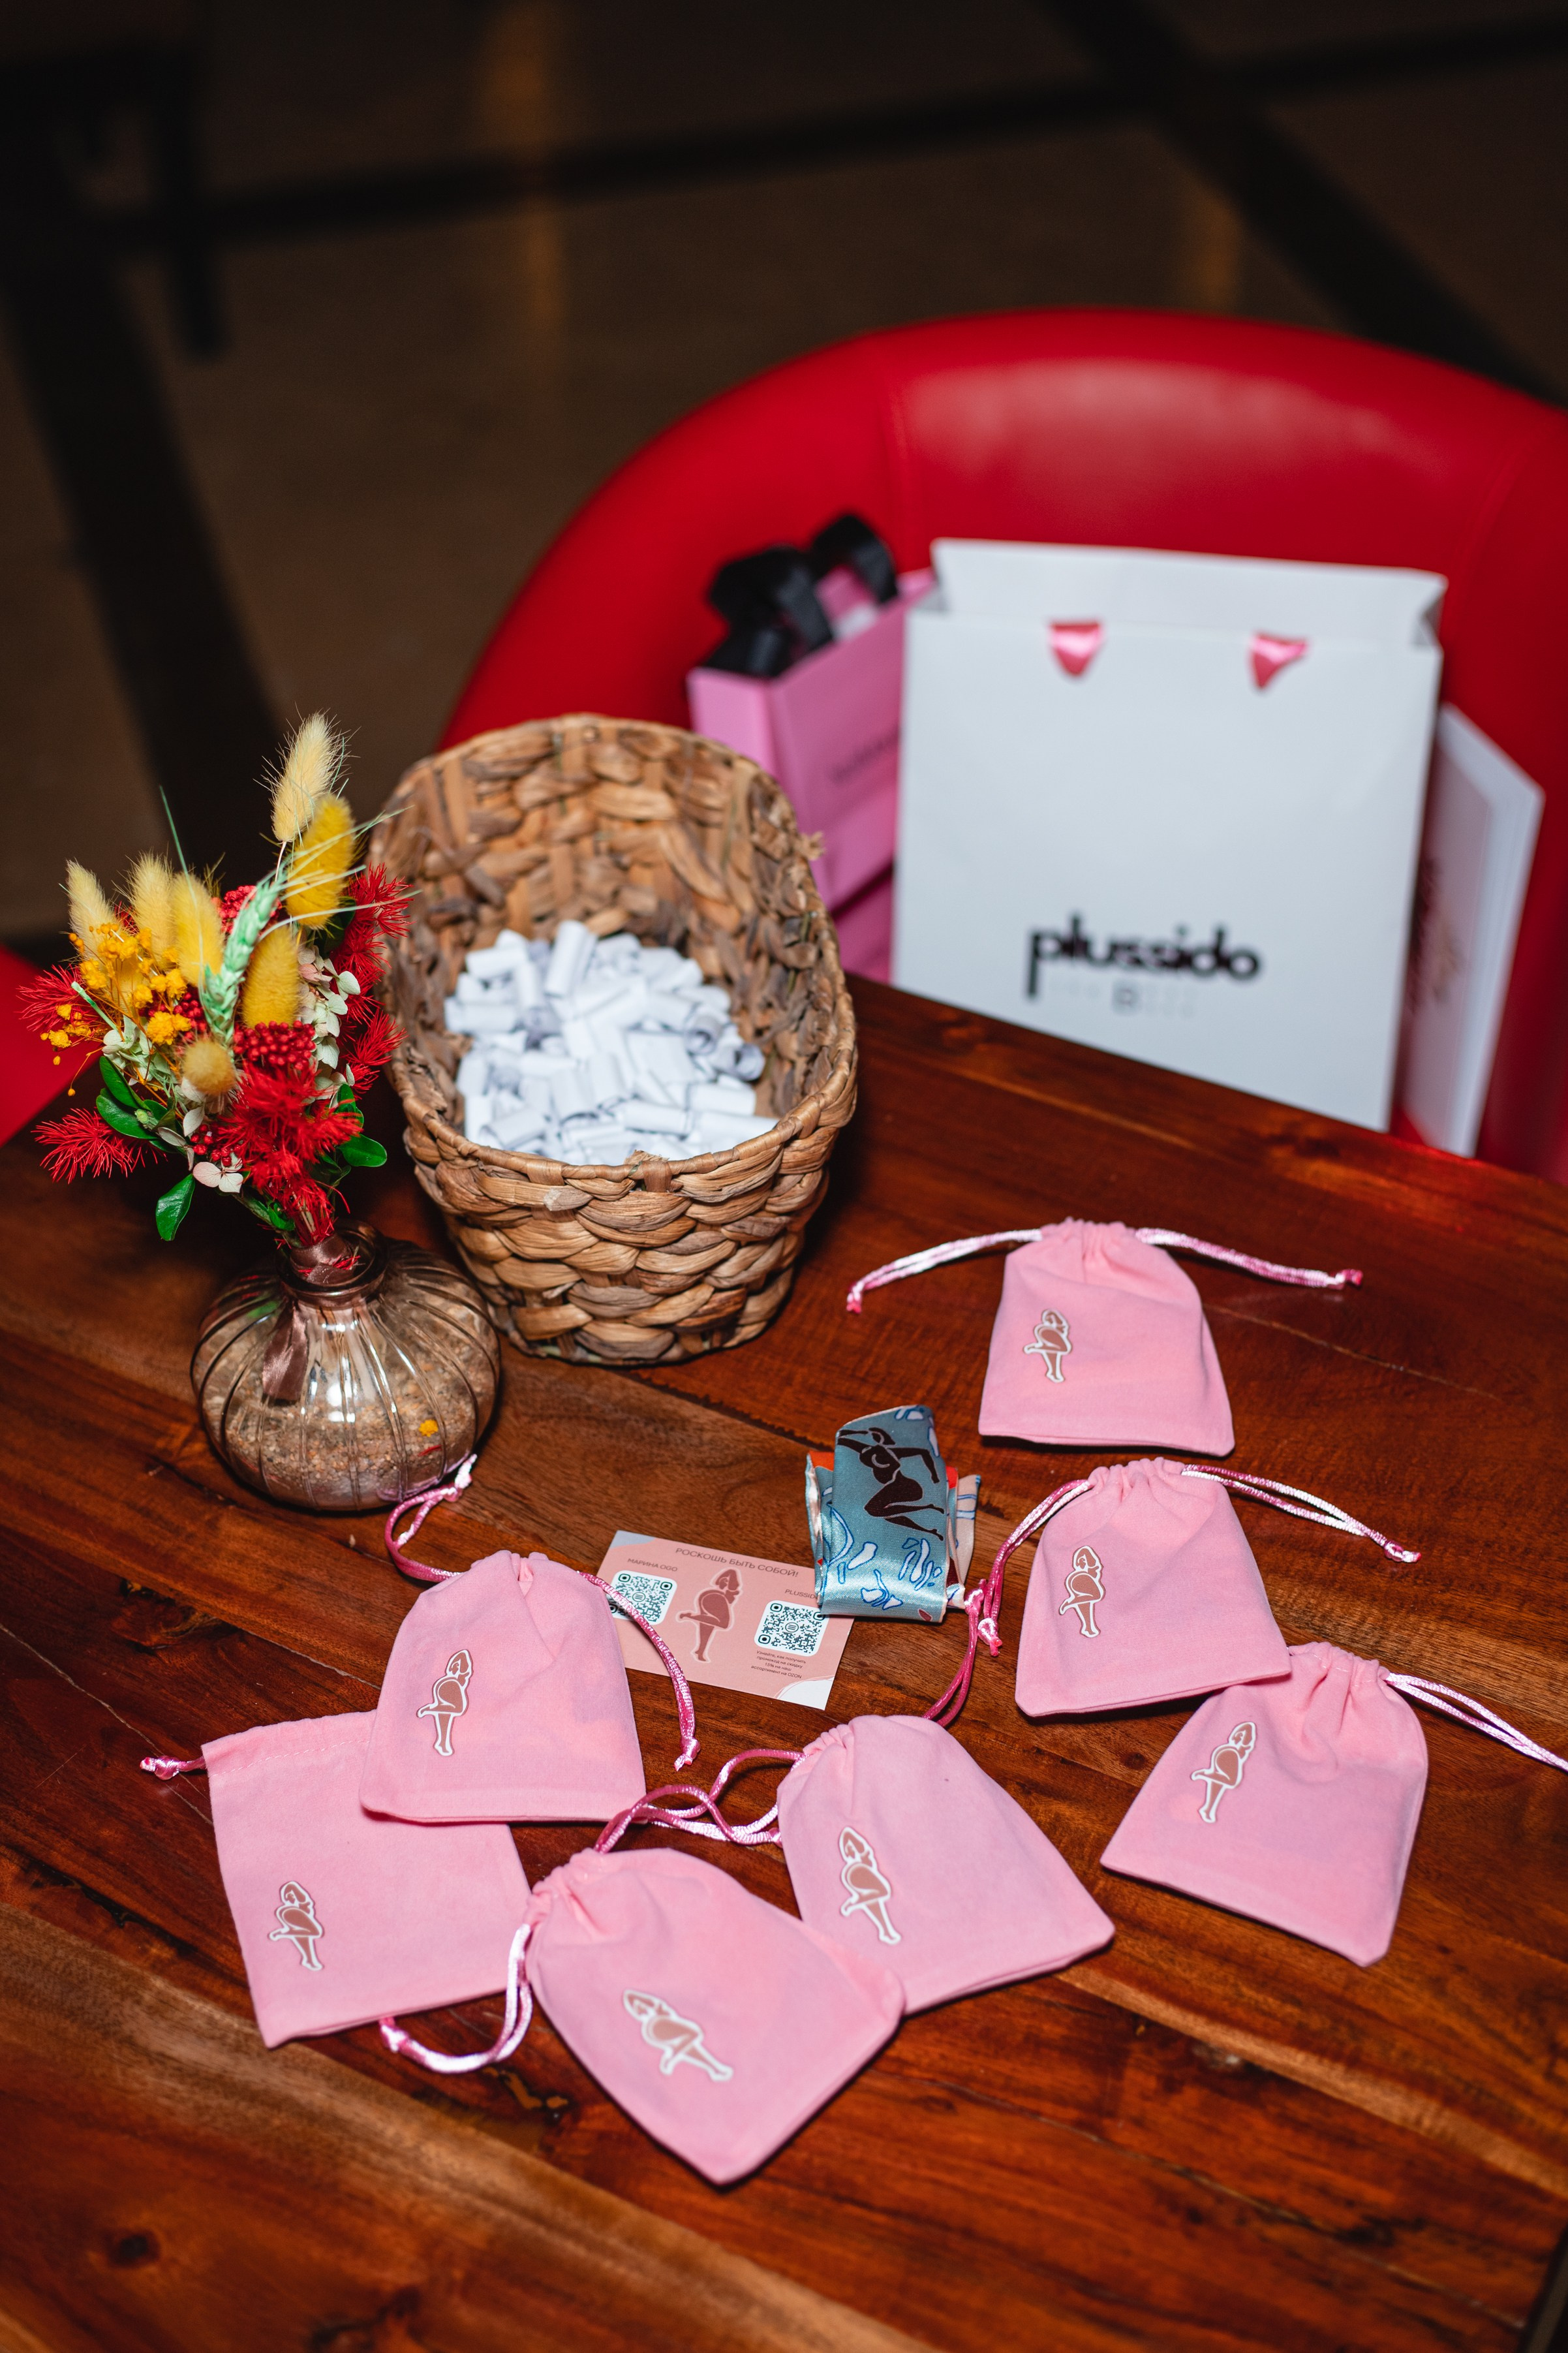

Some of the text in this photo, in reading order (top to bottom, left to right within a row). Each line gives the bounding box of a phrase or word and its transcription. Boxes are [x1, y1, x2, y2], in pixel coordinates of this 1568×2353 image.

[1026, 913, 1261, 999] plussido
[628, 1558, 658, 1568] МАРИНА
[675, 1548, 799, 1578] РОСКОШЬ БЫТЬ СОБОЙ!
[785, 1589, 818, 1599] PLUSSID
[751, 1665, 780, 1674] ассортимент
